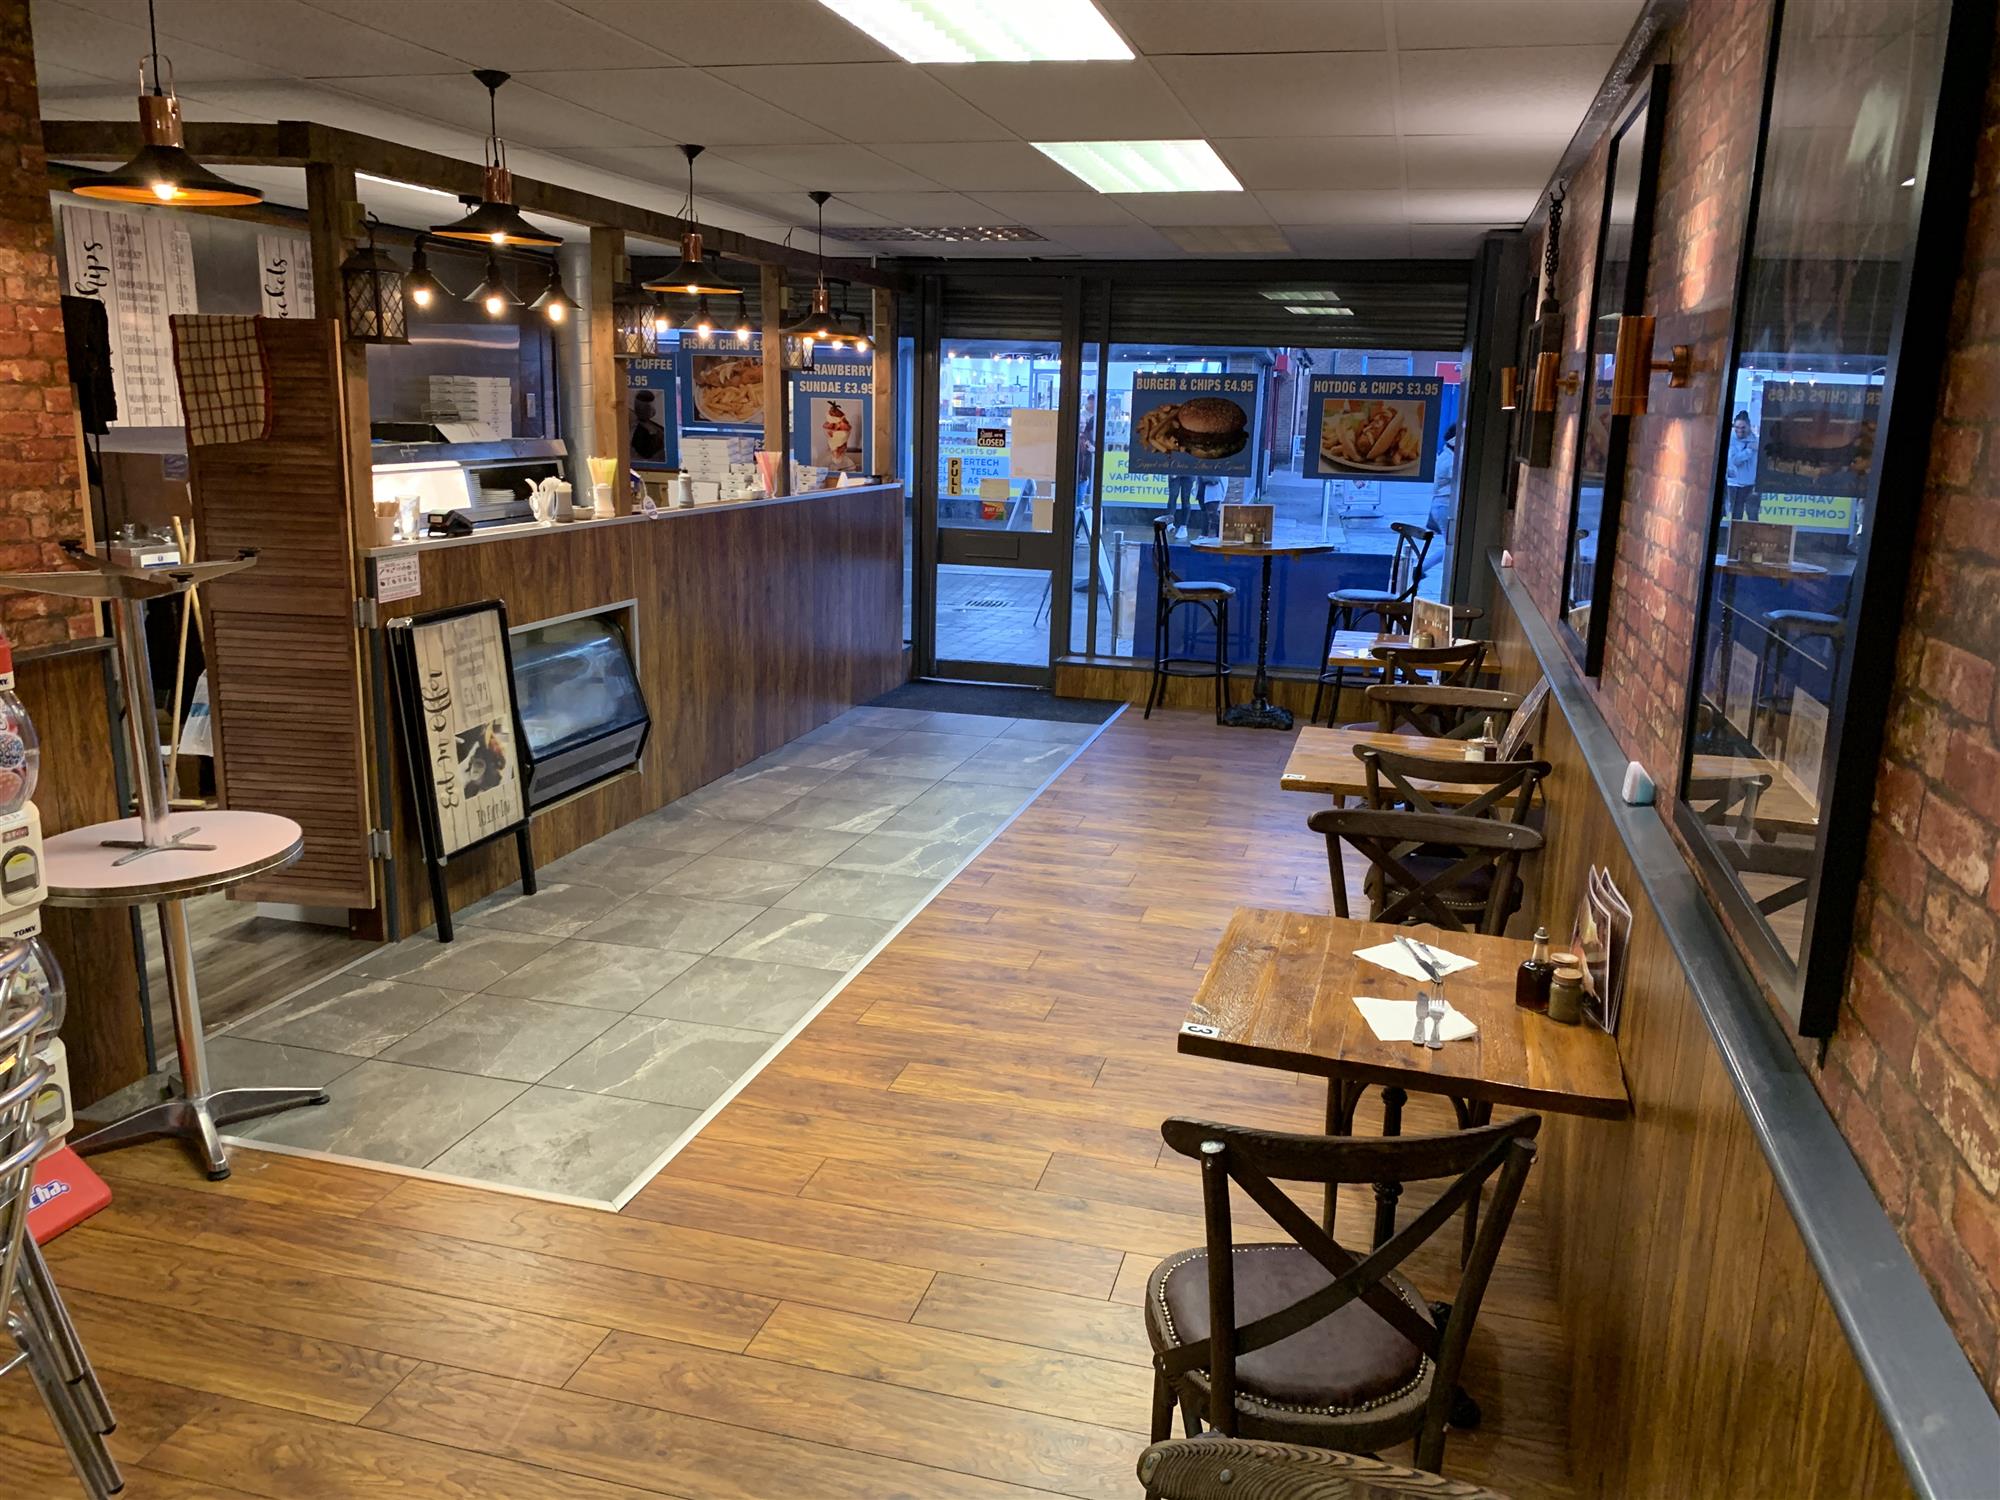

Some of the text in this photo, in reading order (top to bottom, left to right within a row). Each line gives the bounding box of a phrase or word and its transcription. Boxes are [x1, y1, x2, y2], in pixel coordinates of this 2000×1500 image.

[75, 241, 111, 300] hips
[719, 338, 750, 351] CHIPS
[634, 358, 673, 370] COFFEE
[801, 364, 872, 377] RAWBERRY
[799, 380, 841, 393] SUNDAE
[1136, 378, 1254, 392] BURGER & CHIPS £4.95
[1314, 381, 1439, 395] HOTDOG & CHIPS £3.95
[978, 438, 1005, 447] CLOSED
[951, 459, 959, 495] PULL
[970, 468, 1000, 476] TESLA
[1109, 473, 1149, 482] VAPING
[13, 925, 36, 939] TOMY
[1187, 1025, 1213, 1035] 3
